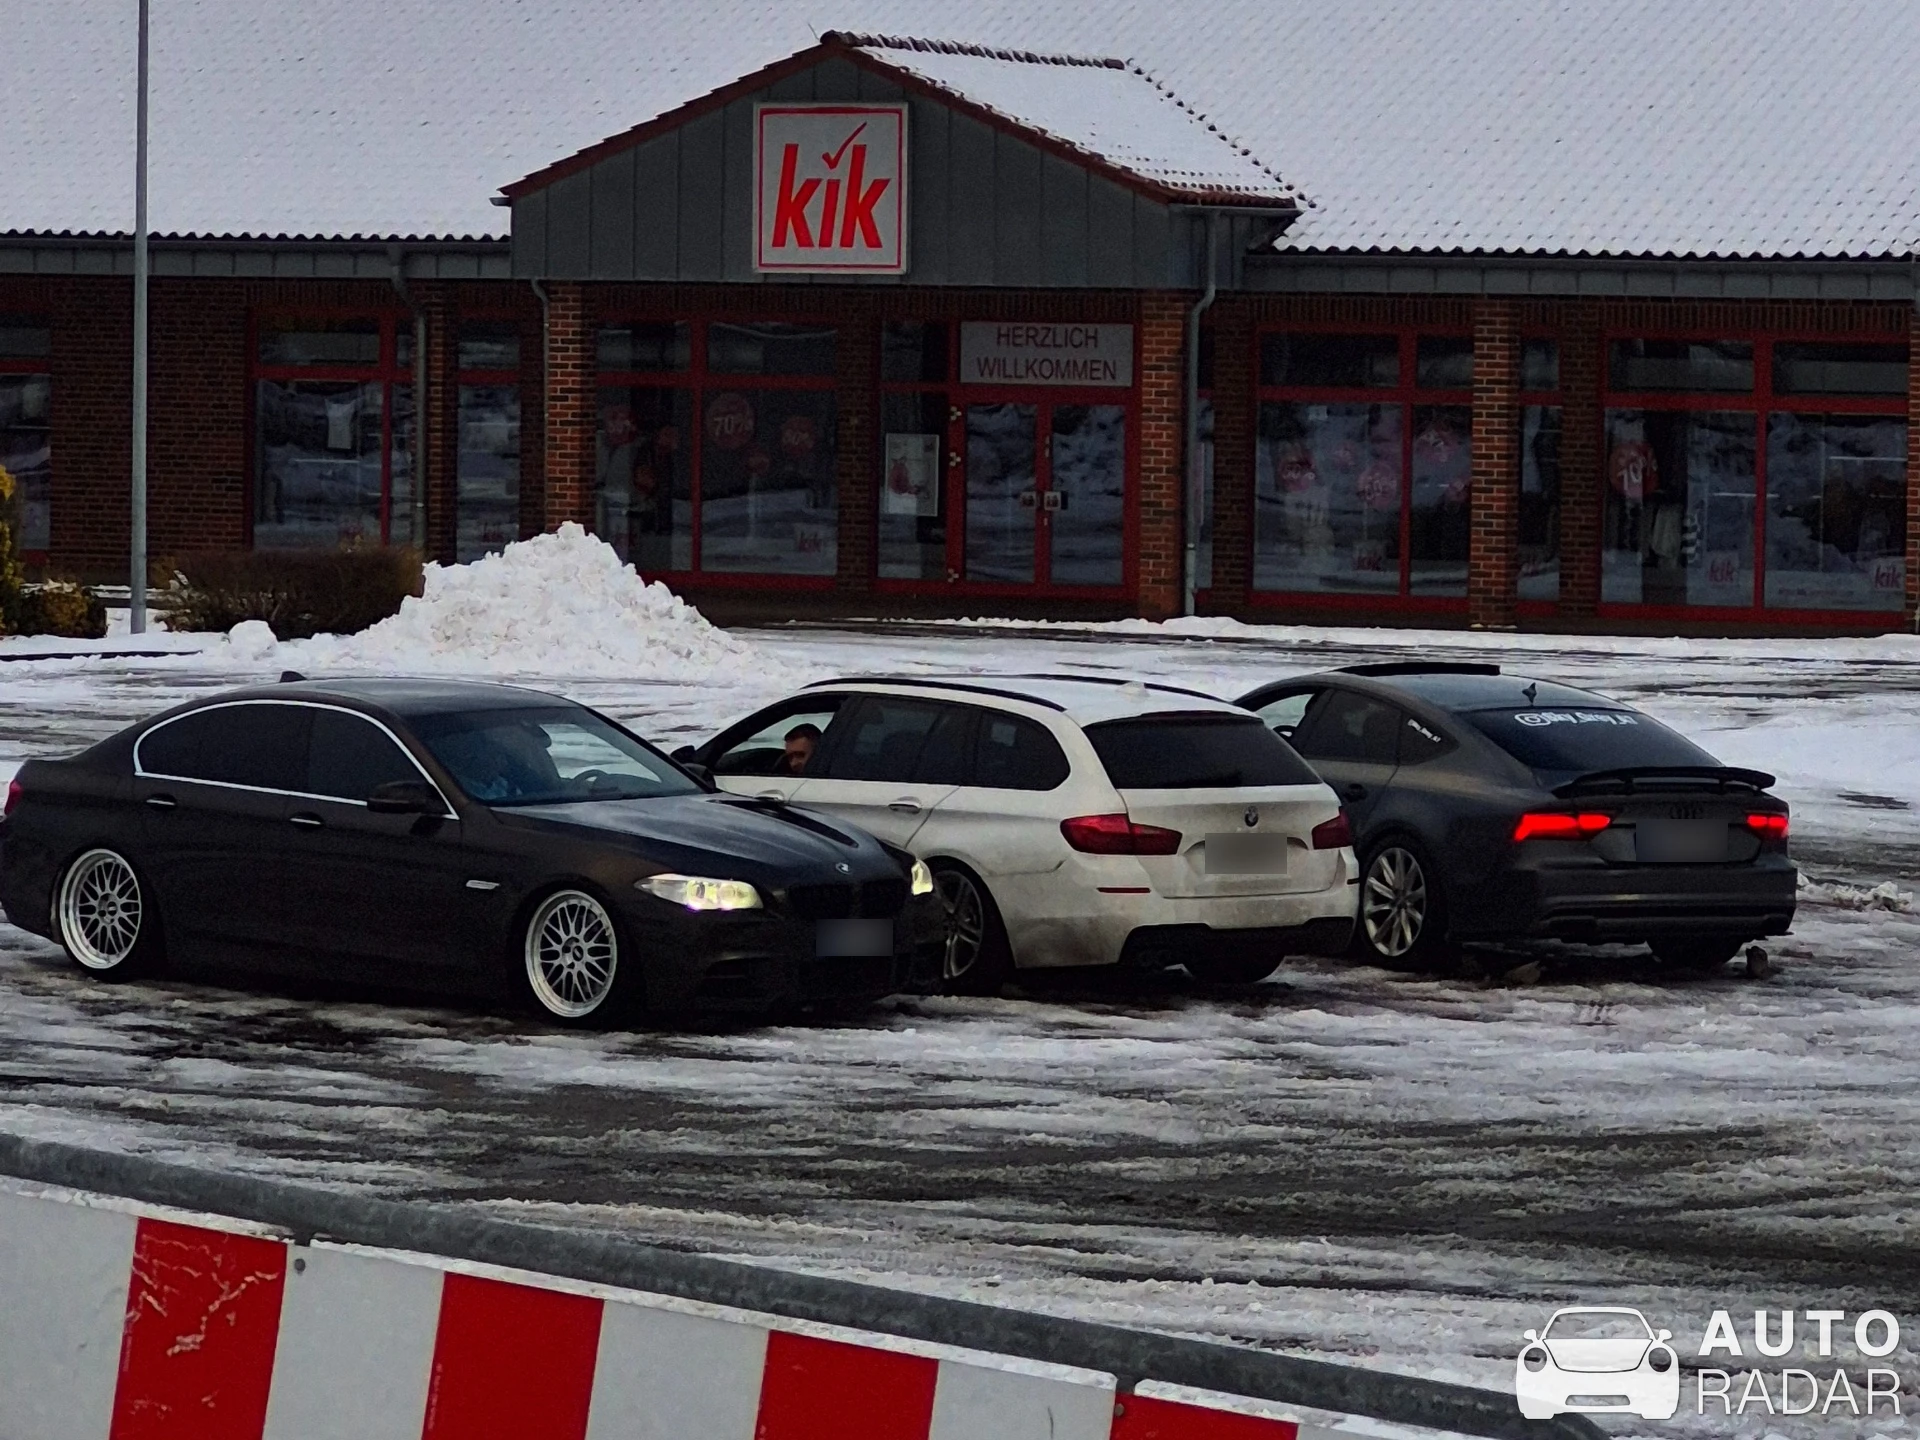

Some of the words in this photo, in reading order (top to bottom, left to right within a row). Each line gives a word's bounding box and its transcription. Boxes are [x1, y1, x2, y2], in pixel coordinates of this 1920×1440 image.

[772, 121, 891, 249] kik
[996, 326, 1099, 349] HERZLICH
[976, 356, 1117, 381] WILLKOMMEN
[1873, 564, 1902, 588] kik
